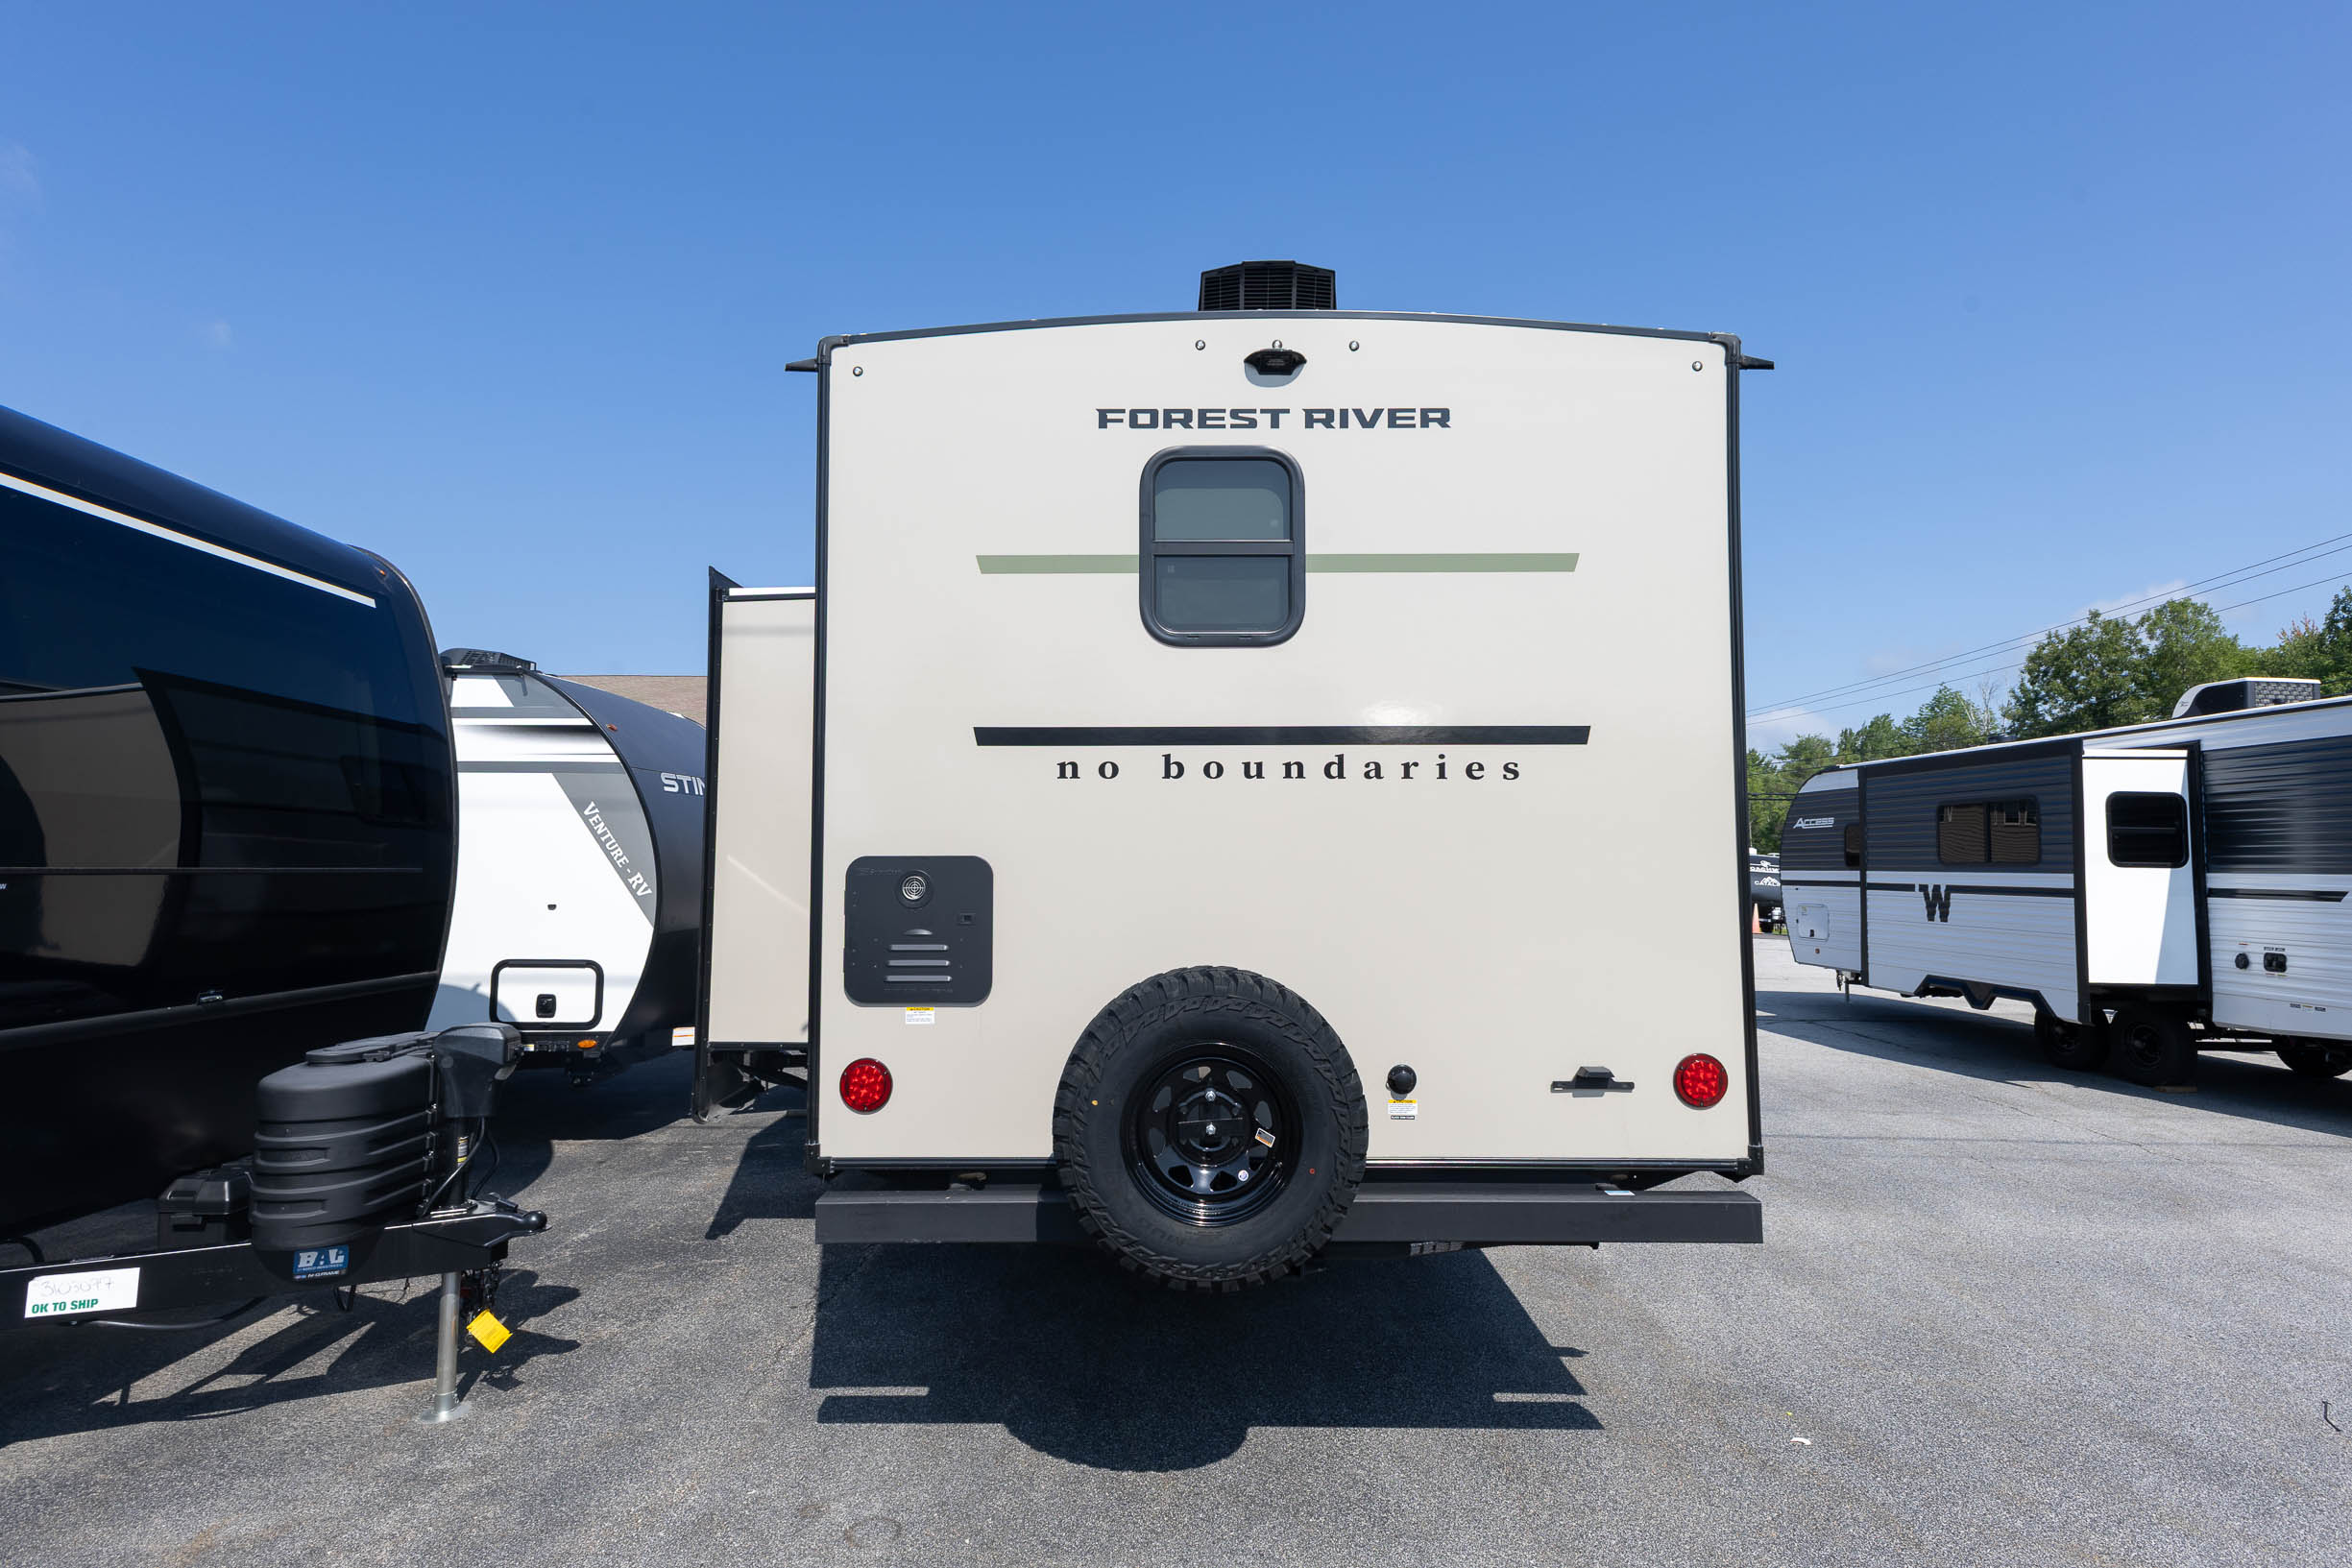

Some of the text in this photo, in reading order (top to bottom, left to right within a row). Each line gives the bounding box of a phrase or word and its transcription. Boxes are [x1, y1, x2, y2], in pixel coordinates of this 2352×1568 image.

[1096, 407, 1452, 429] FOREST RIVER
[1056, 753, 1520, 781] no boundaries
[583, 801, 630, 868] VENTURE
[627, 872, 653, 897] RV
[1919, 884, 1952, 922] W
[32, 1298, 99, 1315] OK TO SHIP
